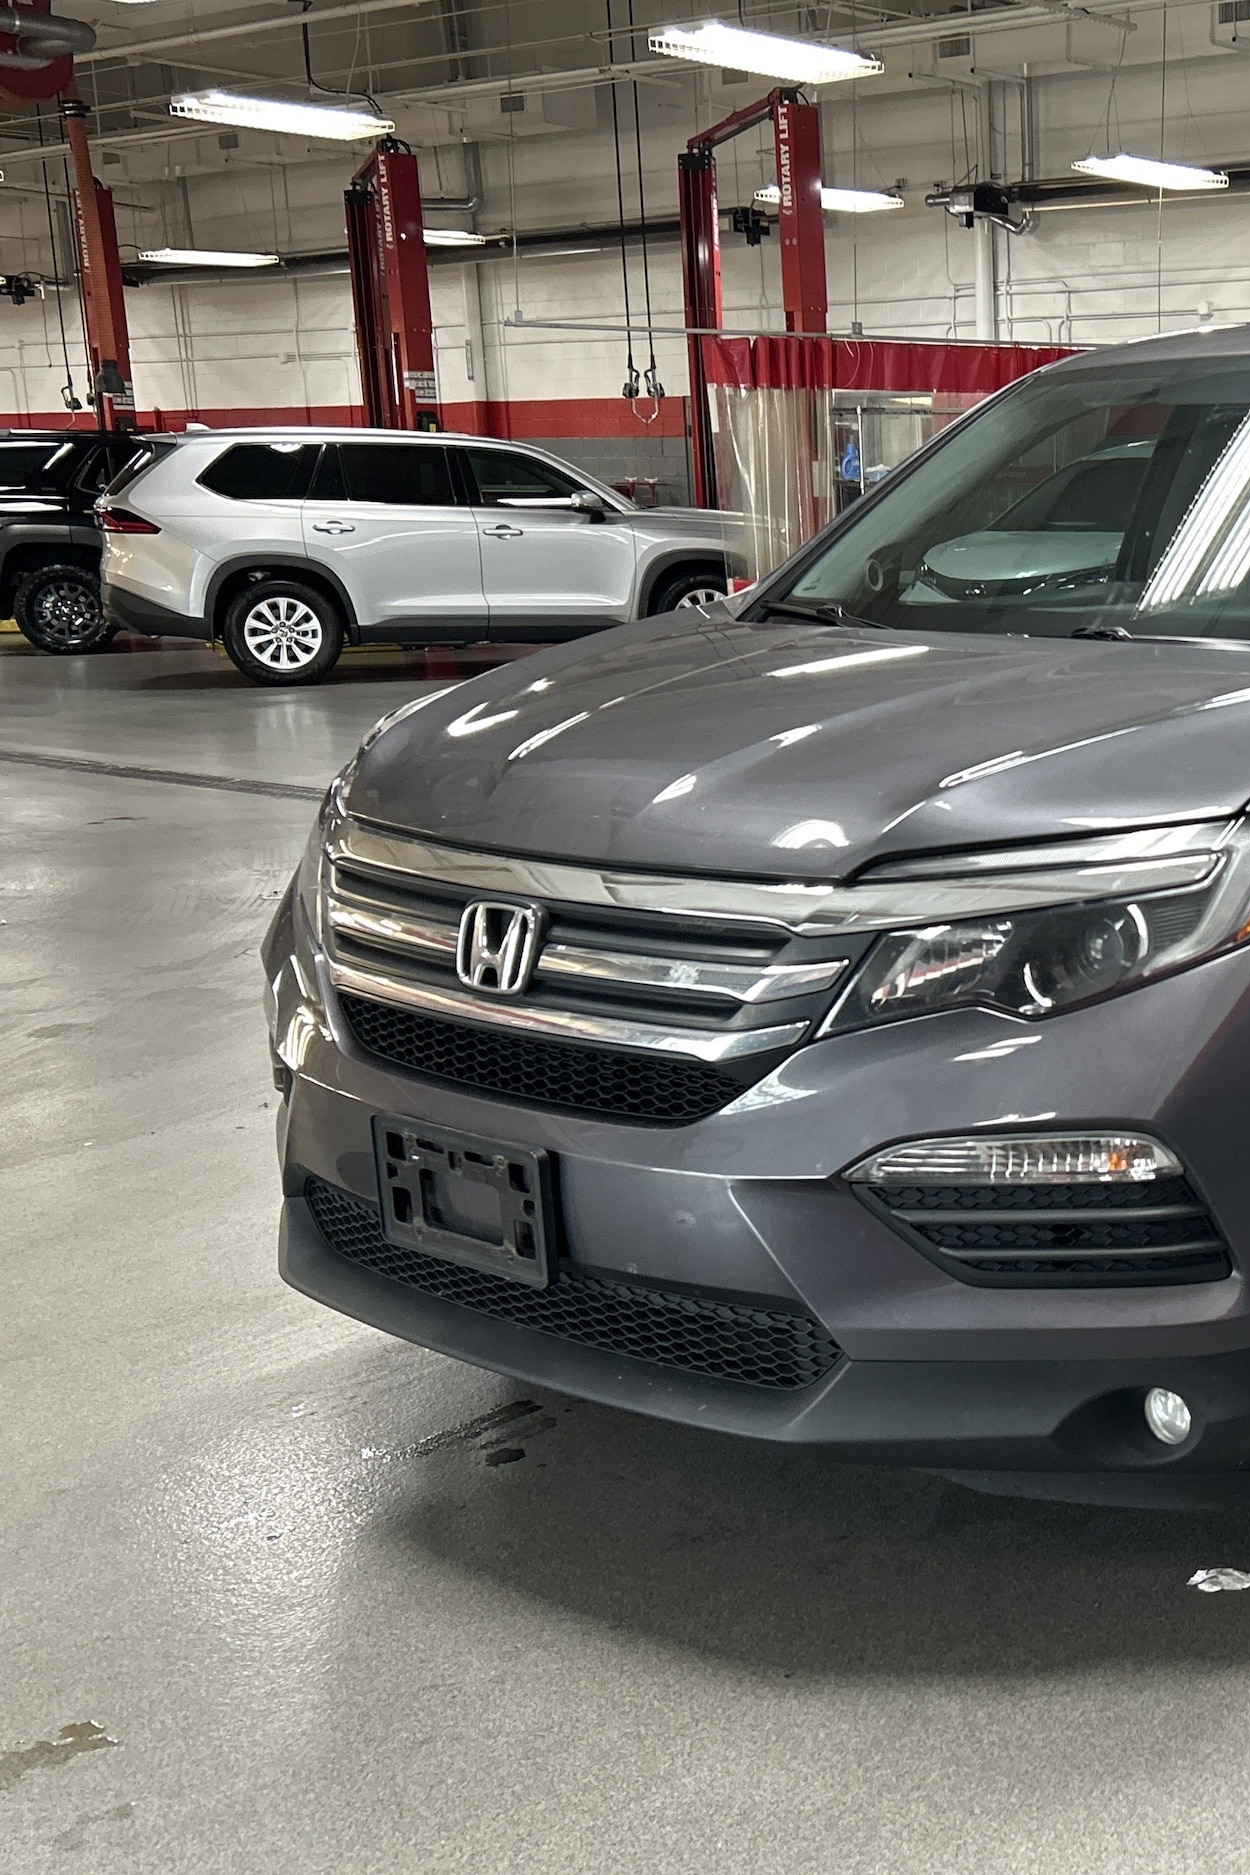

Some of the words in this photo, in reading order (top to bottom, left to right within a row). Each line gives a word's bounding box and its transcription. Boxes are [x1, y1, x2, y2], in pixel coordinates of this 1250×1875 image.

[778, 106, 789, 139] LIFT
[377, 154, 388, 183] LIFT
[780, 144, 791, 207] ROTARY
[381, 187, 394, 242] ROTARY
